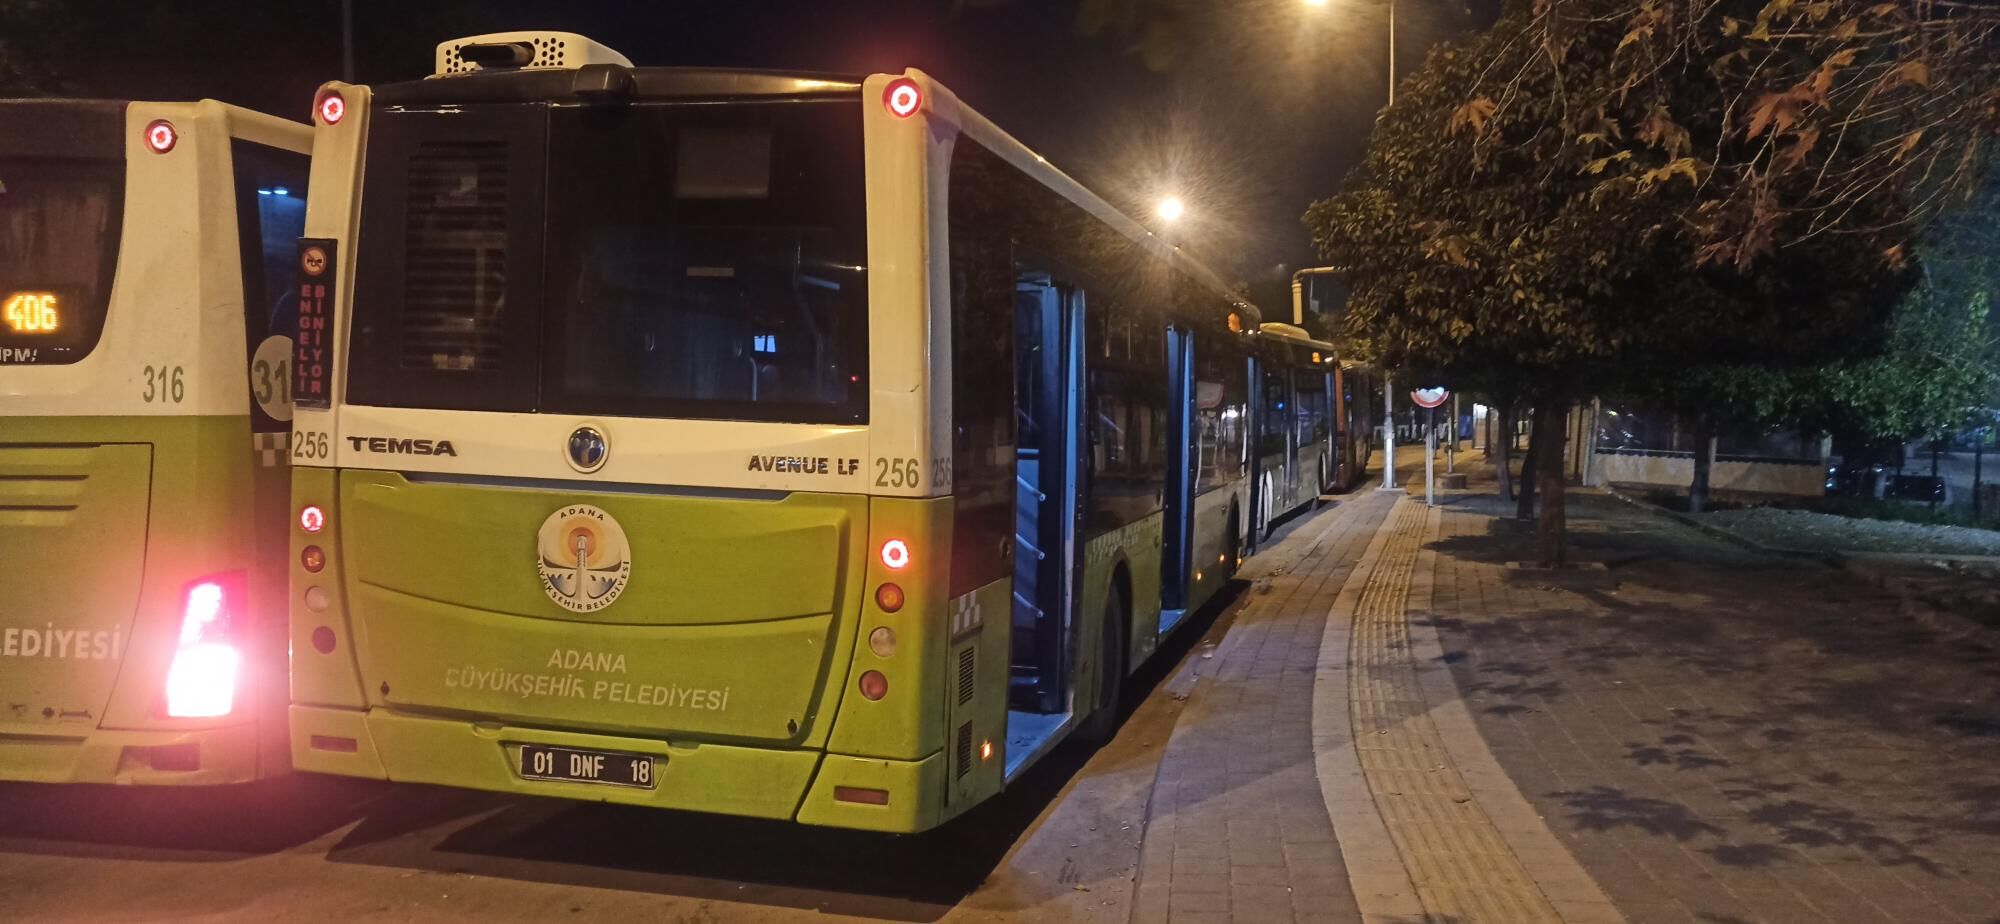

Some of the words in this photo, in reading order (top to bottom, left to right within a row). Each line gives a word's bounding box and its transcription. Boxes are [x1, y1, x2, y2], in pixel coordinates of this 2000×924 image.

[7, 294, 57, 331] 406
[143, 365, 185, 403] 316
[254, 360, 289, 404] 31
[294, 431, 328, 459] 256
[346, 436, 458, 457] TEMSA
[748, 455, 829, 475] AVENUE
[837, 458, 860, 475] LF
[875, 457, 919, 488] 256
[932, 457, 951, 488] 256
[560, 507, 605, 521] ADANA
[0, 622, 121, 659] EDİYESİ
[546, 649, 627, 674] ADANA
[533, 752, 553, 775] 01
[570, 757, 605, 779] DNF
[630, 761, 650, 784] 18
